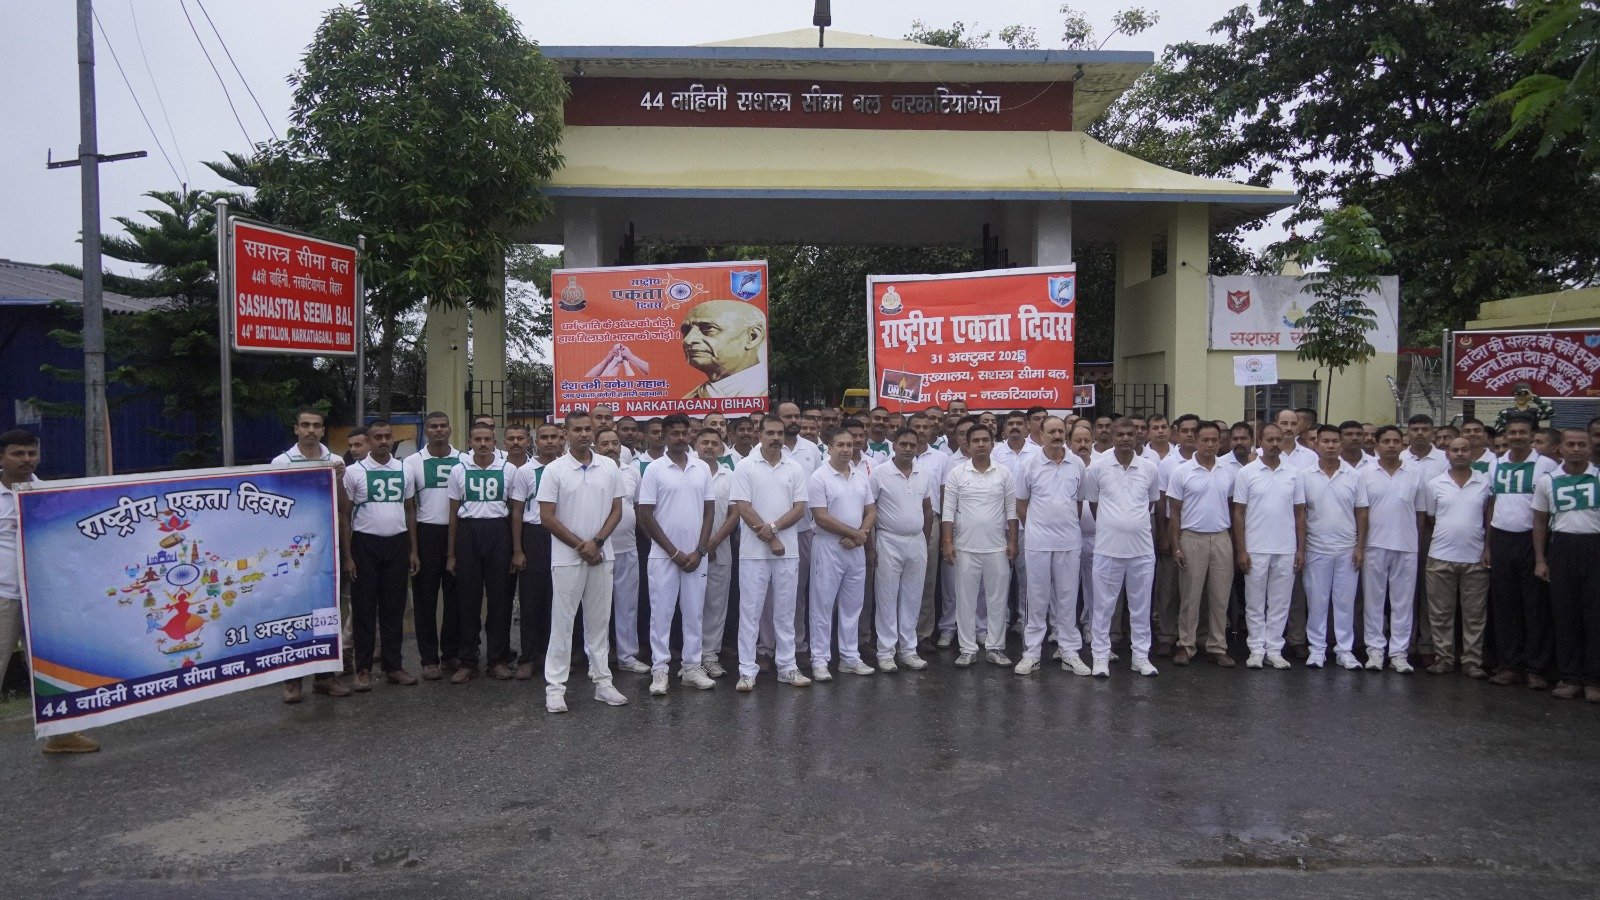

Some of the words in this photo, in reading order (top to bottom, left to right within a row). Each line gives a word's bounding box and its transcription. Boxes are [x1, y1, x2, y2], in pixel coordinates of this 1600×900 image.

[640, 92, 664, 110] 44
[671, 83, 728, 112] वाहिनी
[737, 91, 791, 113] सशस्त्र
[802, 85, 843, 112] सीमा
[852, 93, 883, 113] बल
[891, 86, 1001, 114] नरकटियागंज
[243, 239, 291, 264] सशस्त्र
[296, 245, 326, 270] सीमा
[330, 257, 349, 274] बल
[610, 288, 664, 301] एकता
[239, 293, 301, 321] SASHASTRA
[303, 301, 333, 324] SEEMA
[335, 305, 353, 326] BAL
[255, 325, 291, 344] BATTALION,
[335, 331, 351, 345] BIHAR
[879, 310, 944, 353] राष्ट्रीय
[950, 313, 1012, 343] एकता
[1017, 304, 1074, 341] दिवस
[1230, 332, 1281, 346] सशस्त्र
[931, 354, 943, 364] 31
[999, 350, 1027, 363] 2025
[978, 369, 1014, 380] सशस्त्र
[1018, 366, 1045, 380] सीमा
[561, 380, 578, 390] देश
[560, 404, 571, 413] 44
[574, 403, 590, 412] BN
[627, 399, 718, 412] NARKATIAGANJ
[721, 398, 765, 412] (BIHAR)
[372, 478, 402, 501] 35
[469, 477, 499, 500] 48
[1497, 469, 1525, 493] 41
[1557, 482, 1595, 511] 57
[77, 494, 158, 540] राष्ट्रीय
[165, 489, 231, 518] एकता
[237, 481, 295, 518] दिवस
[225, 625, 250, 647] 31
[254, 613, 313, 641] अक्टूबर
[41, 700, 68, 717] 44
[76, 686, 128, 710] वाहिनी
[133, 675, 179, 698] सशस्त्र
[183, 666, 217, 687] सीमा
[221, 660, 251, 675] बल,
[255, 640, 331, 669] नरकटियागंज
